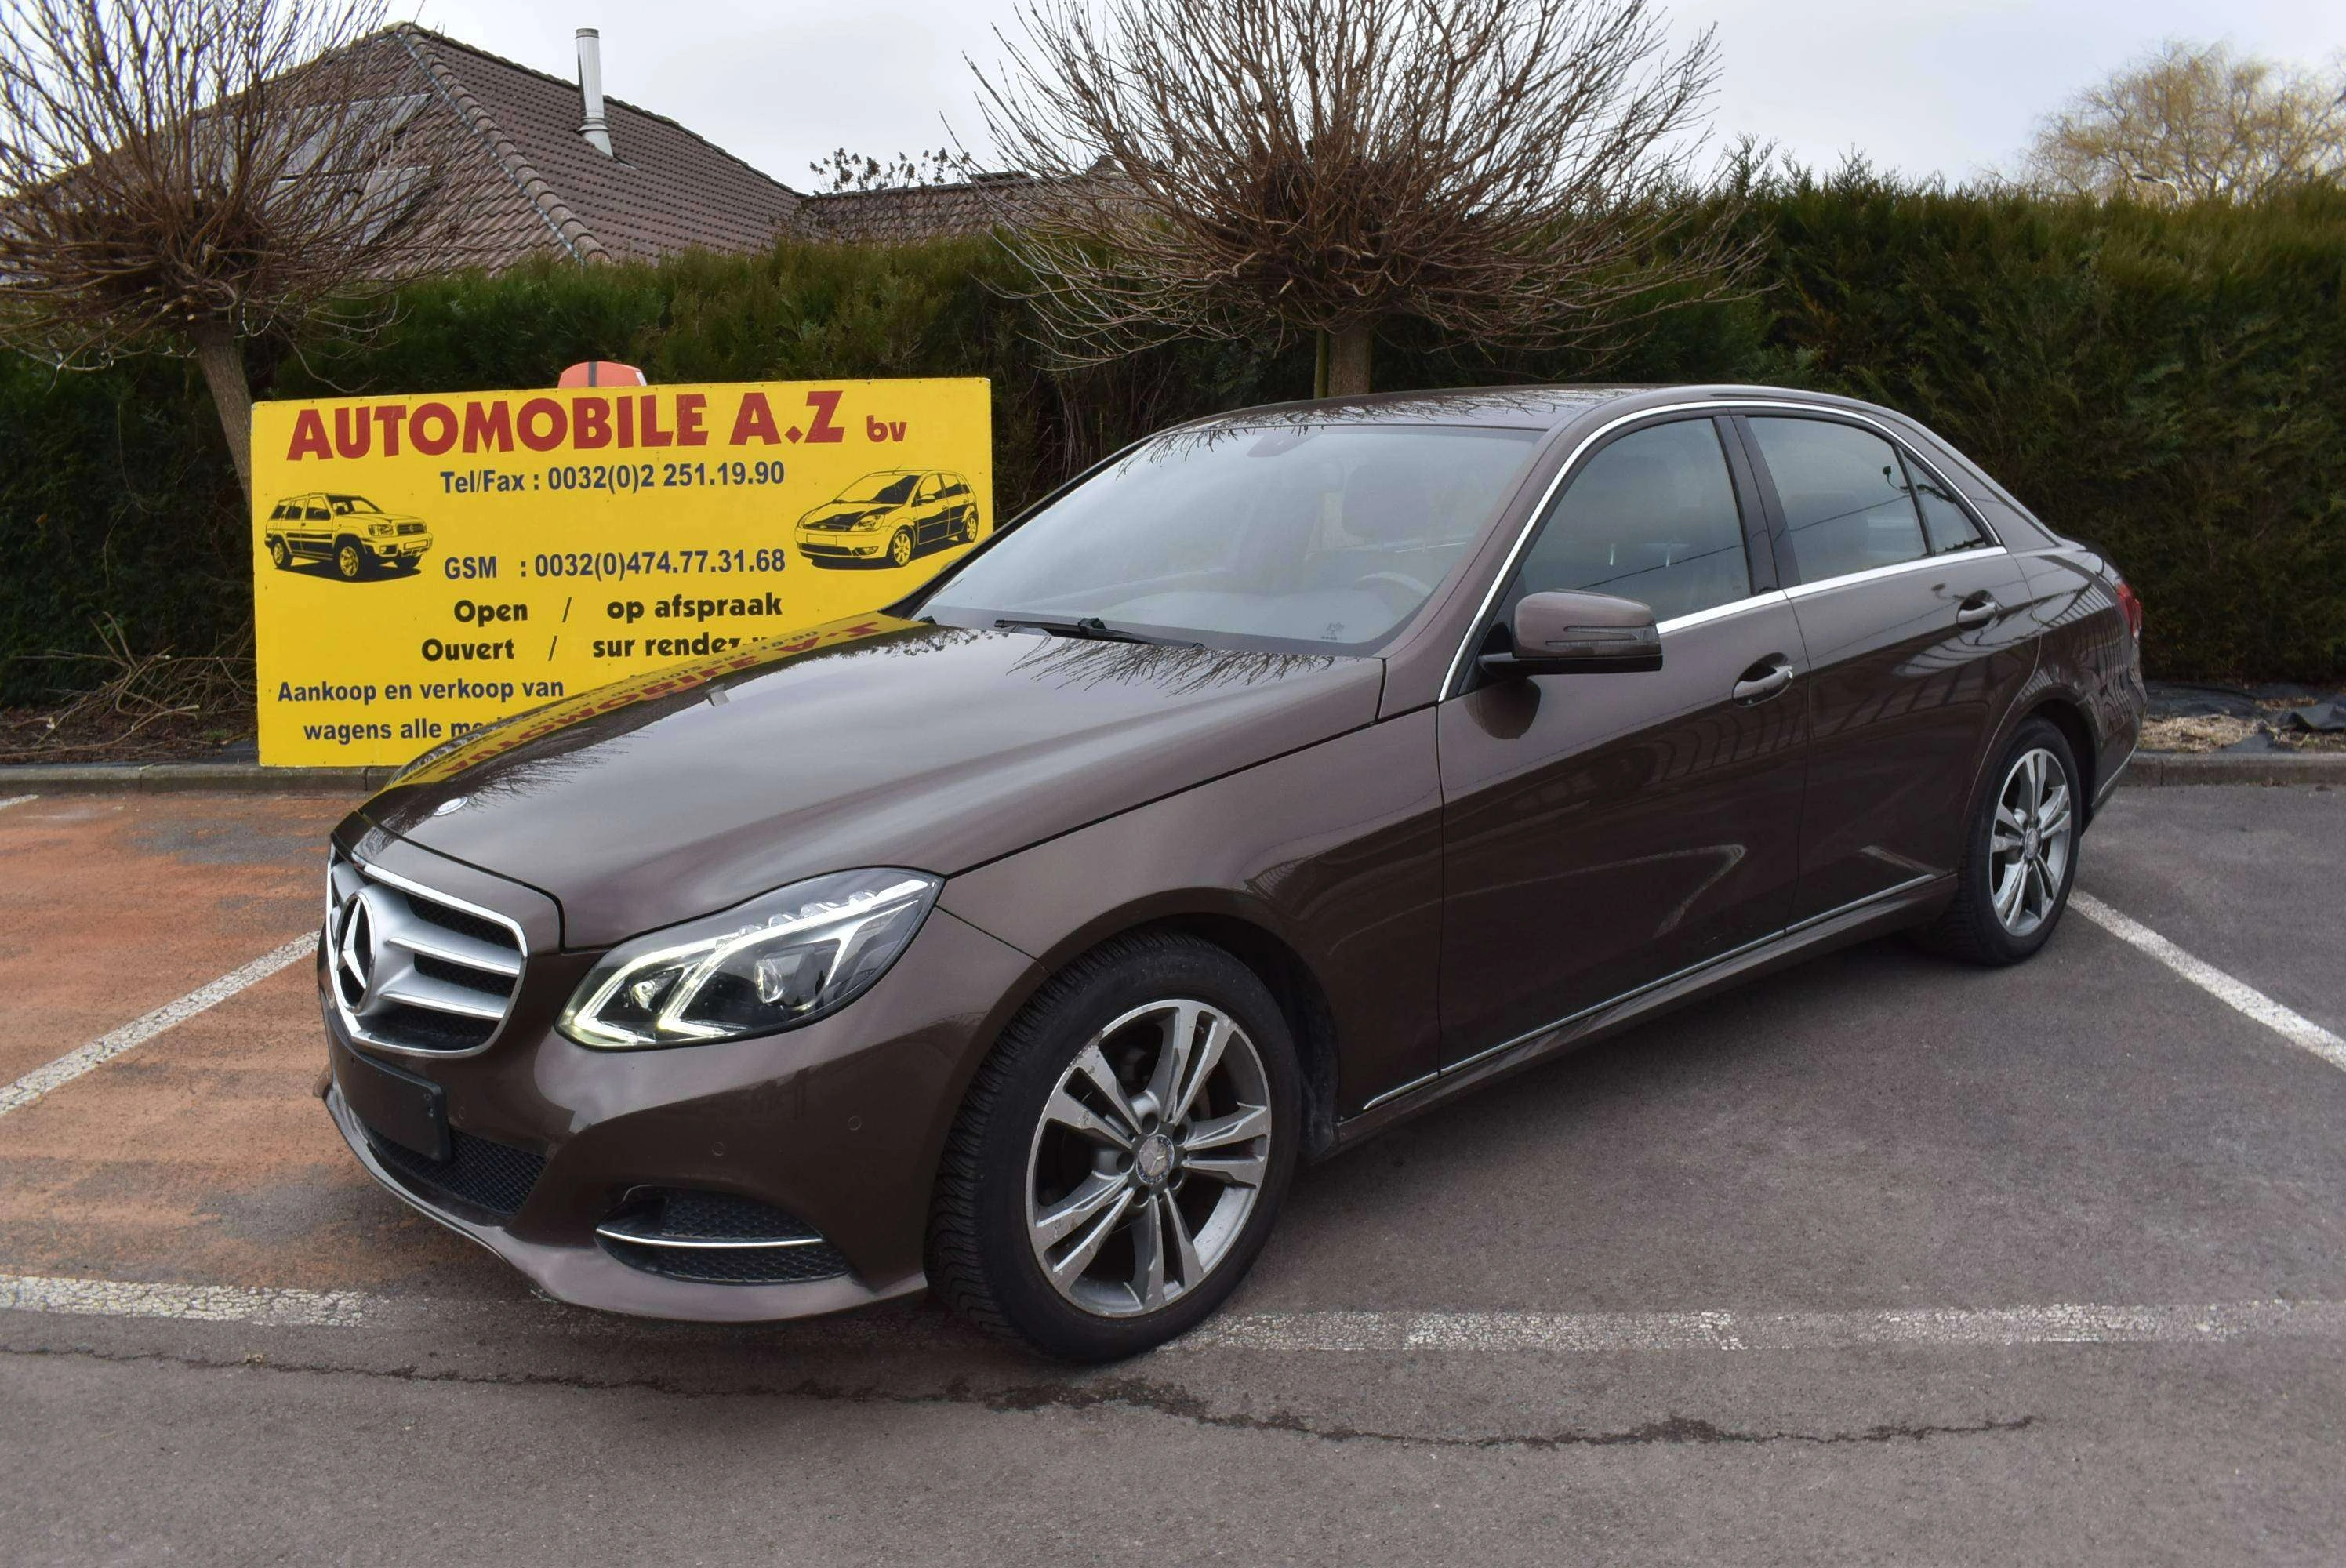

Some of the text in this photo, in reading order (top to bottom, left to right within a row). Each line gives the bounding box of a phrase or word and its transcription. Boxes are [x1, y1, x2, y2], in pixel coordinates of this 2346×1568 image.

[286, 390, 907, 461] AUTOMOBILE A.Z bv
[440, 469, 525, 493] Tel/Fax
[548, 464, 654, 495] 0032(0)2
[664, 460, 784, 487] 251.19.90
[444, 556, 497, 580] GSM
[535, 548, 785, 582] 0032(0)474.77.31.68
[453, 592, 783, 628] Open / op afspraak
[421, 638, 515, 662] Ouvert
[548, 635, 558, 662] /
[593, 639, 636, 659] sur
[278, 677, 564, 706] Aankoop en verkoop van
[303, 723, 392, 746] wagens
[400, 717, 443, 739] alle
